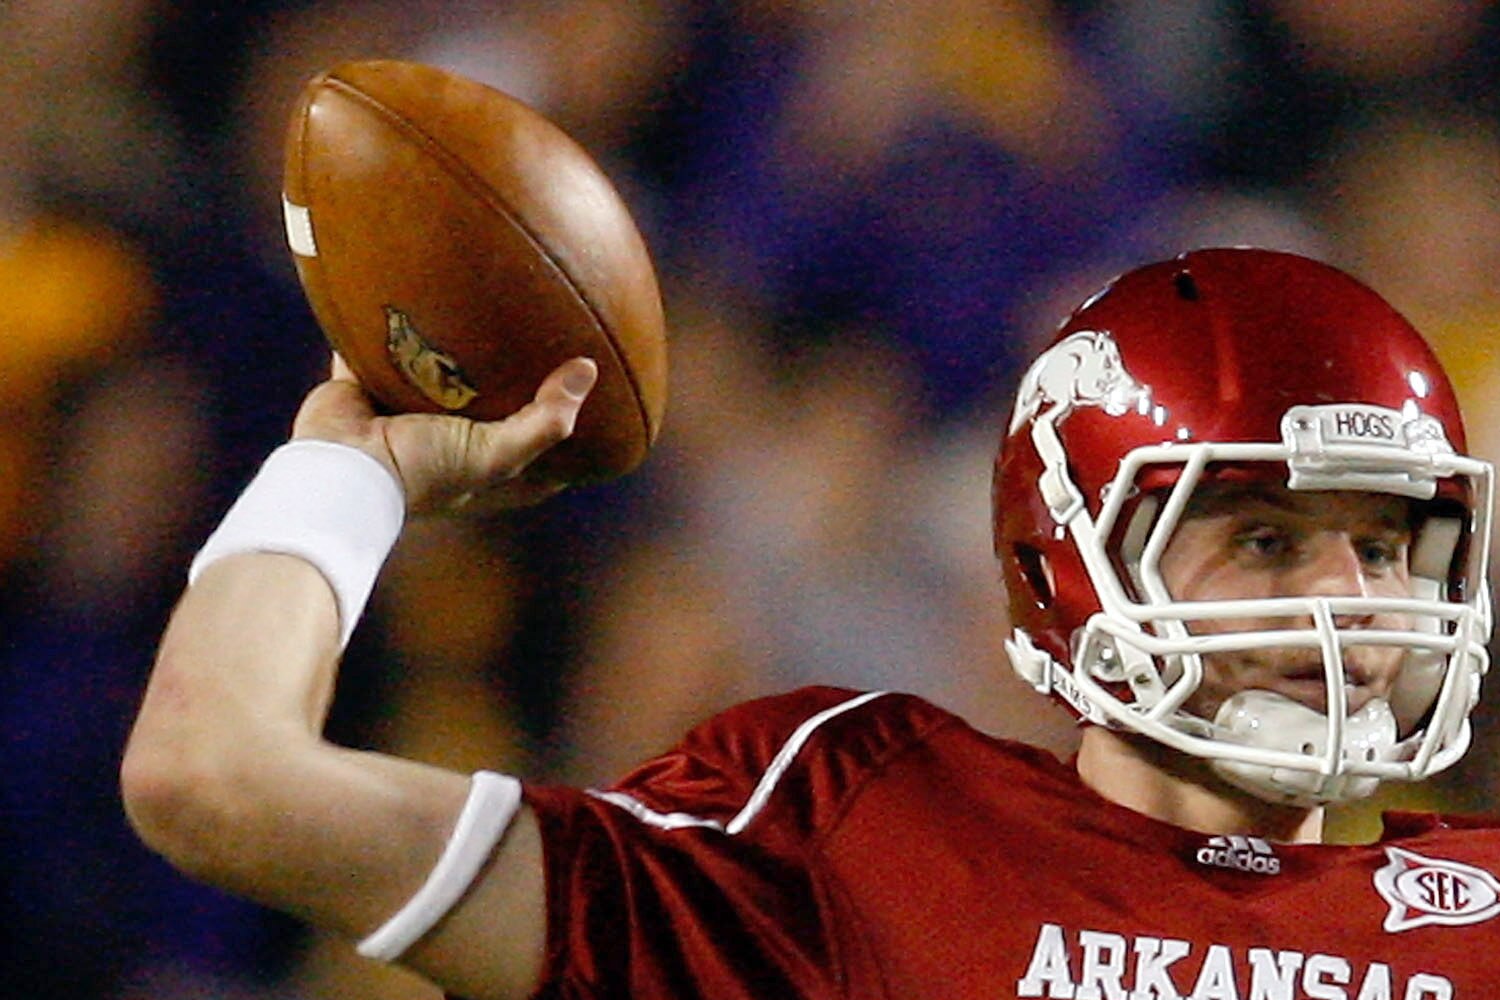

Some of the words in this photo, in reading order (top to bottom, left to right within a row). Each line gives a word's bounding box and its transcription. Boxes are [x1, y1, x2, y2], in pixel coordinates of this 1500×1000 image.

[1335, 412, 1395, 439] HOGS
[1197, 847, 1280, 875] adidas
[1415, 871, 1472, 911] SEC
